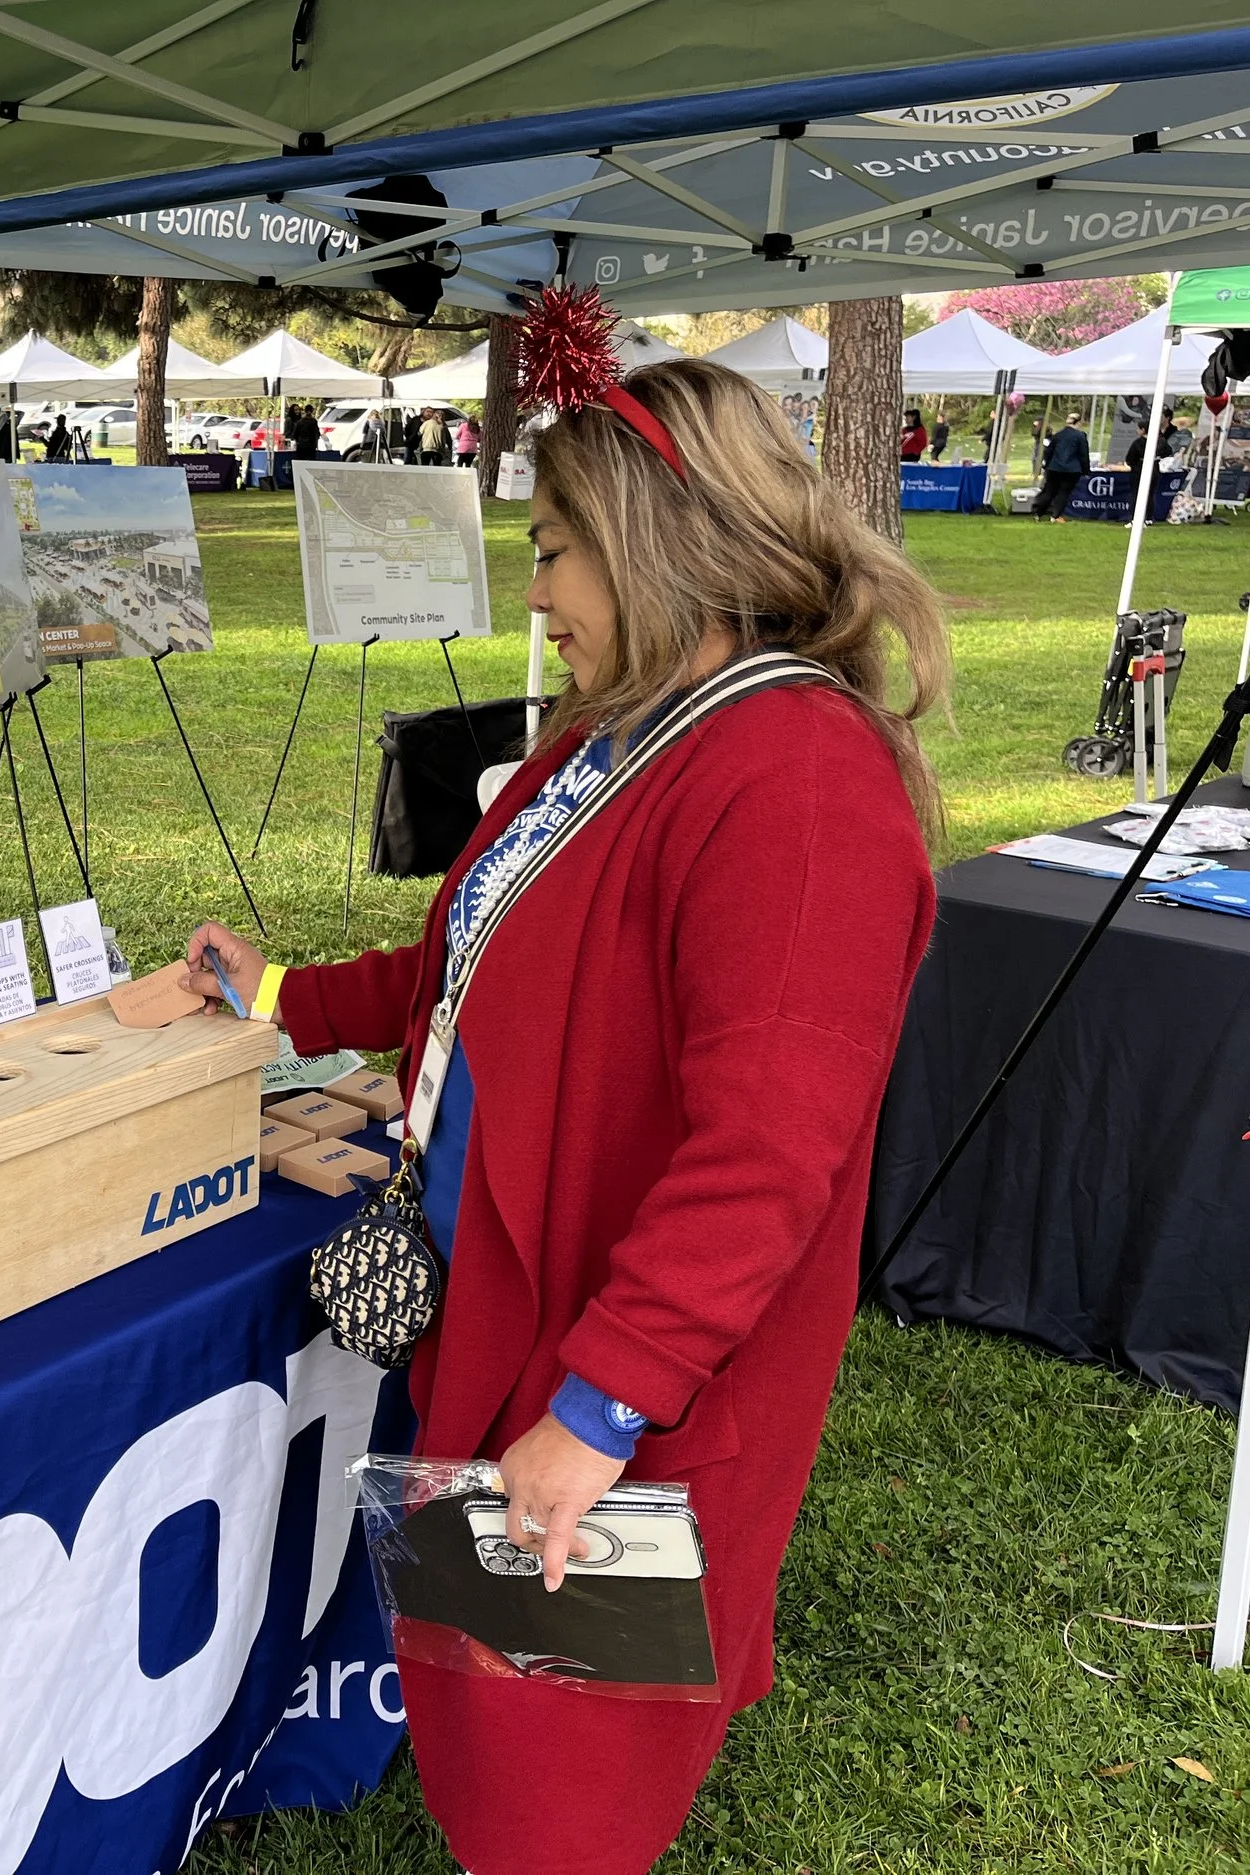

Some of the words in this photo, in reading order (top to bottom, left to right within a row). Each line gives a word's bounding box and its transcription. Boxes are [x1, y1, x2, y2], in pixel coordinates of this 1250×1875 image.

[360, 612, 408, 626] Community
[410, 612, 426, 624] Site
[427, 612, 445, 624] Plan
[45, 629, 80, 641] CENTER
[46, 643, 67, 652] Market
[72, 641, 95, 650] Pop-Up
[56, 963, 73, 973] SAFER
[74, 954, 104, 968] CROSSINGS
[3, 979, 28, 991] SEATING
[359, 1078, 387, 1093] LADOT
[299, 1102, 333, 1116] LADOT
[316, 1148, 354, 1164] LADOT
[140, 1154, 256, 1237] LADOT
